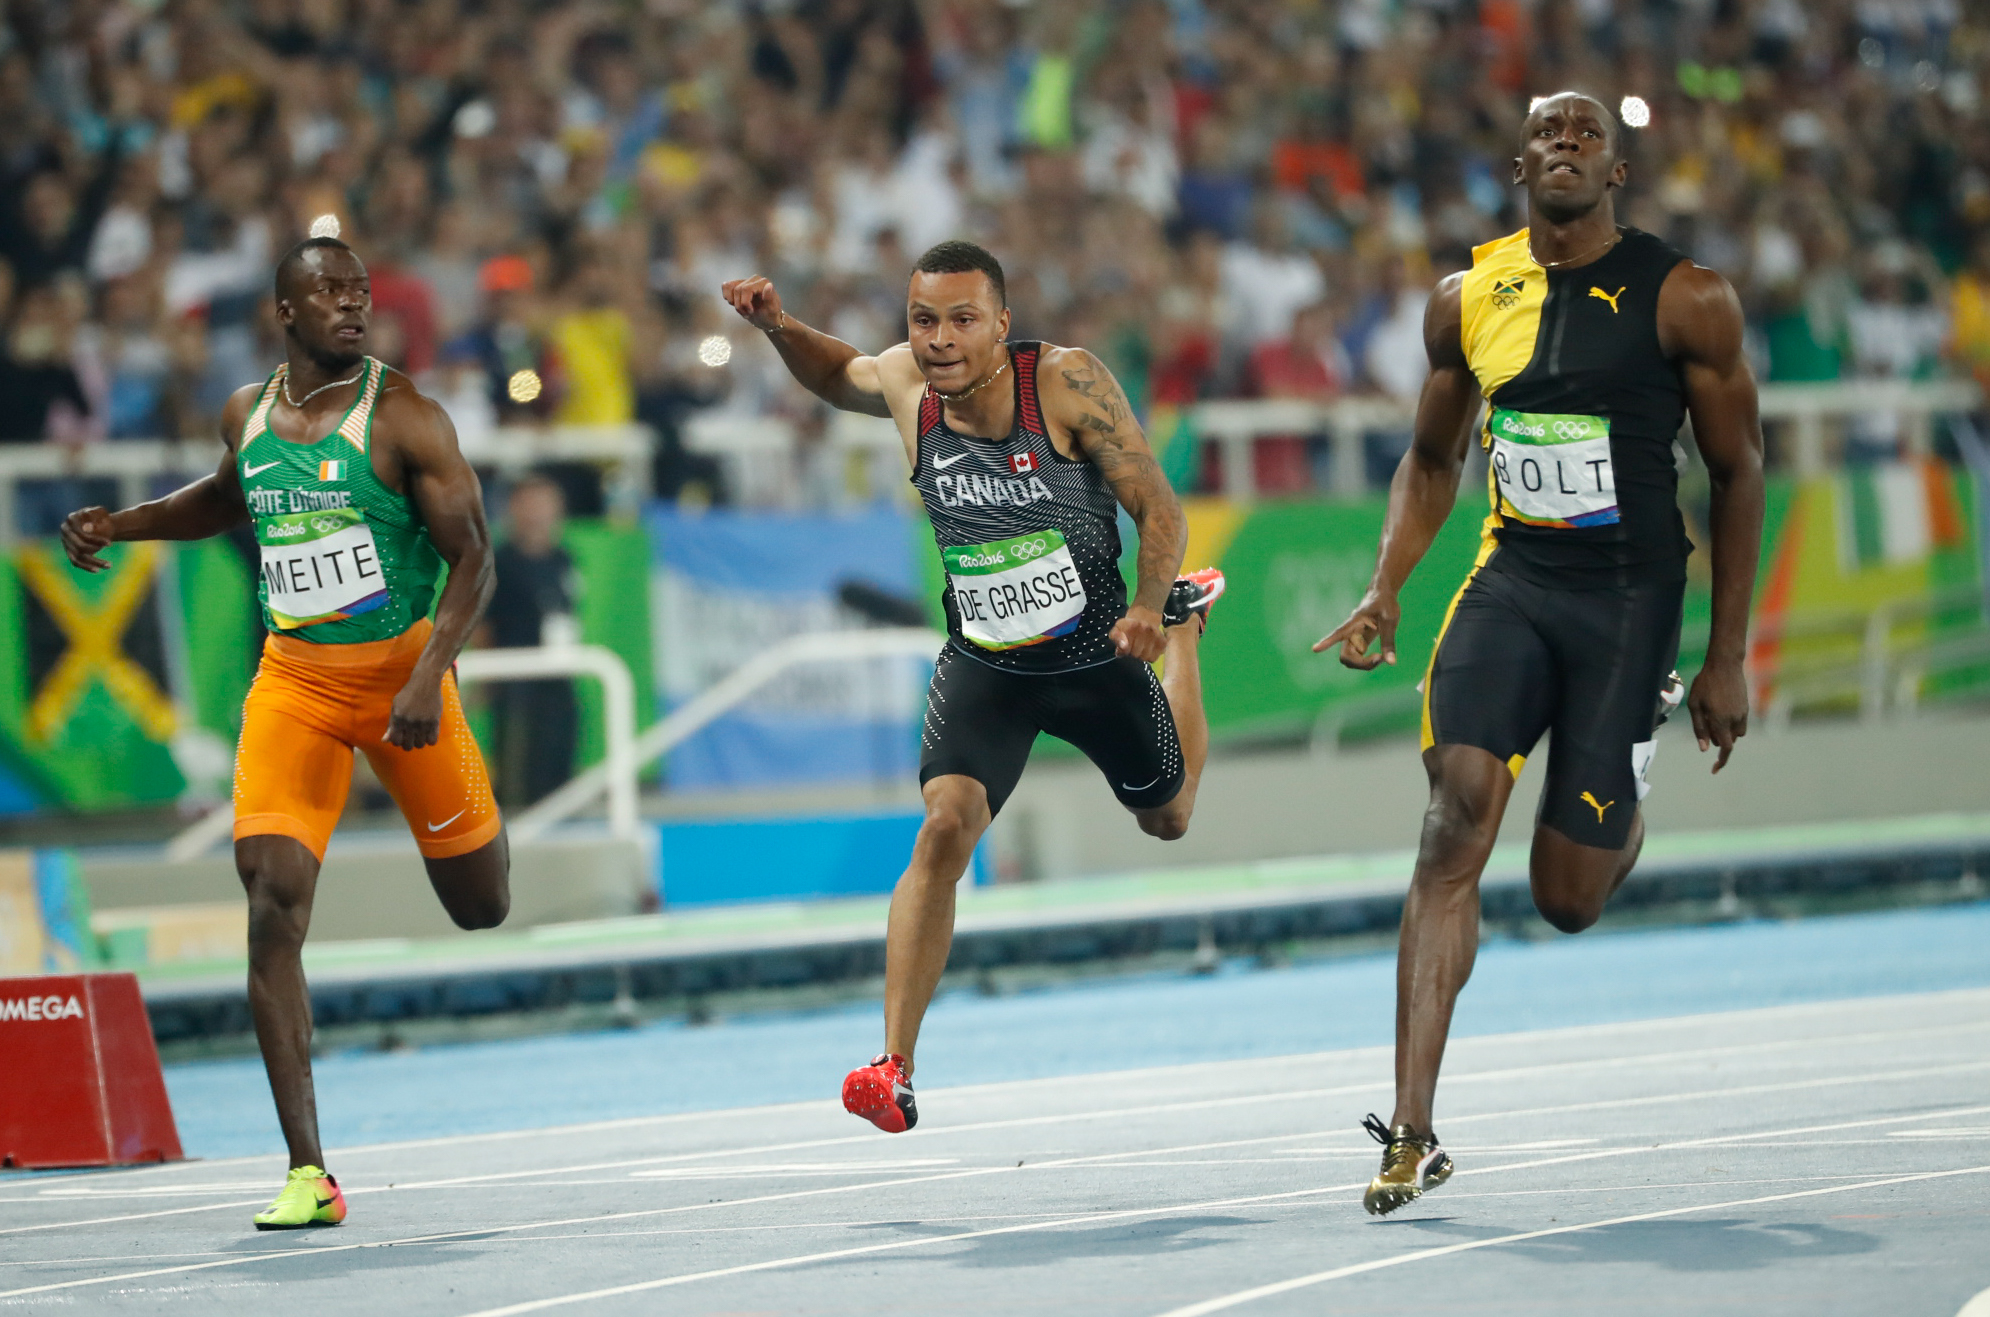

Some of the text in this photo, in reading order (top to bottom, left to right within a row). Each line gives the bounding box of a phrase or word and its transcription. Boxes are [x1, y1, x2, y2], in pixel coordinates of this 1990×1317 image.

[1502, 417, 1546, 437] Rio2016
[1494, 451, 1608, 495] BOLT
[249, 485, 286, 514] CÔTE
[935, 474, 1054, 507] CANADA
[266, 521, 306, 538] Rio2016
[264, 543, 377, 595] MEITE
[958, 550, 1005, 569] Rio2016
[957, 566, 1082, 622] DE GRASSE
[0, 994, 84, 1022] MEGA
